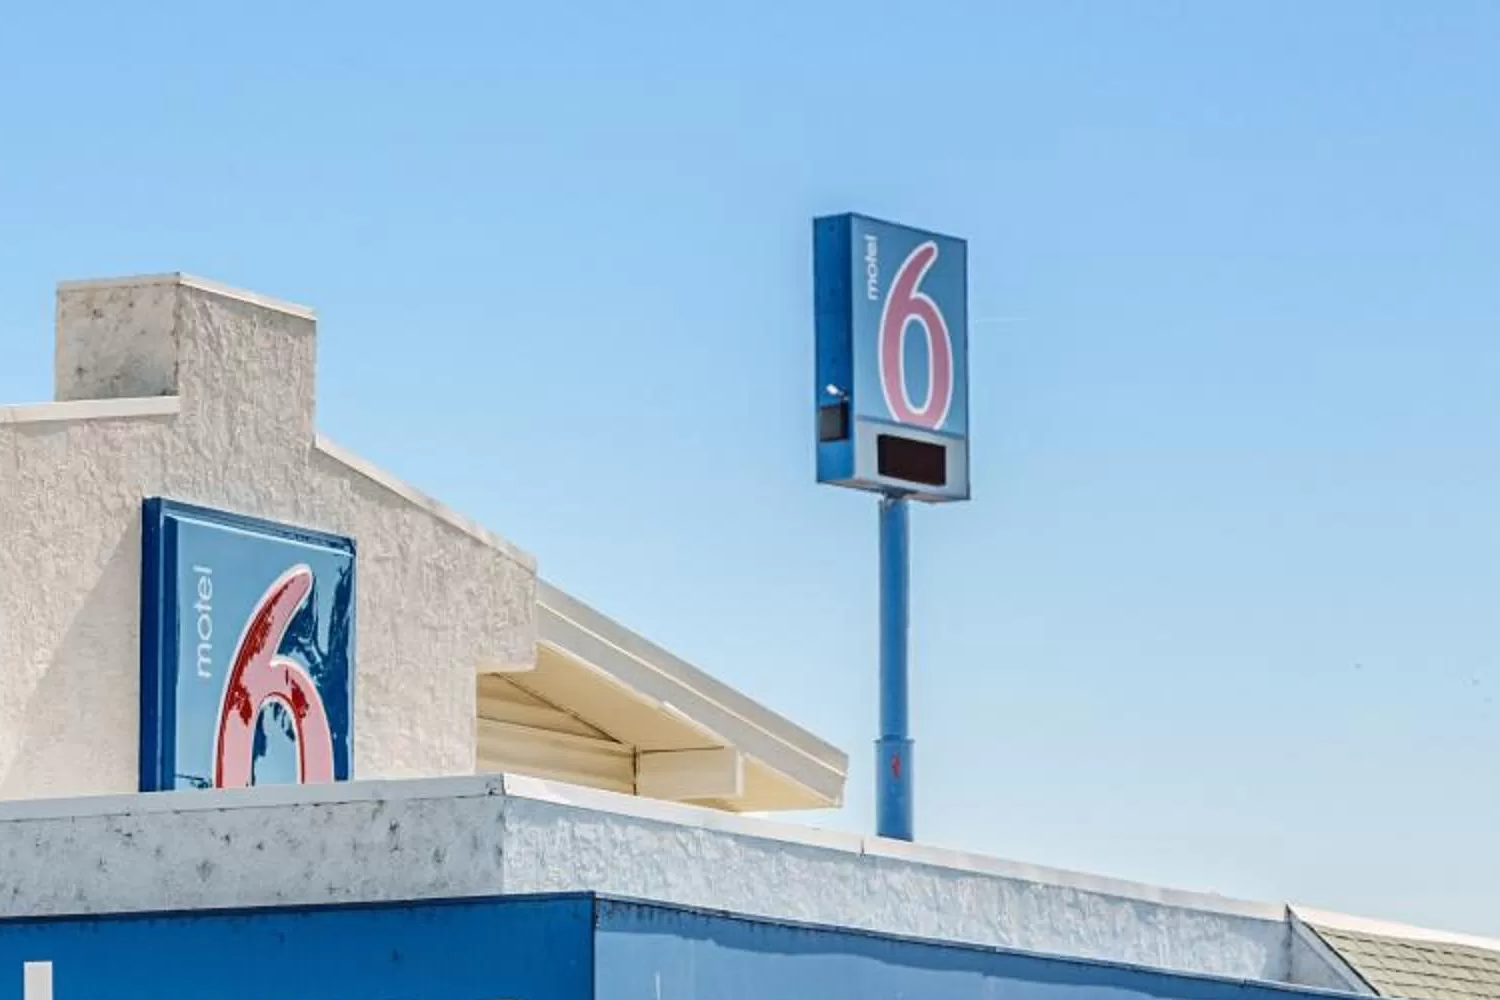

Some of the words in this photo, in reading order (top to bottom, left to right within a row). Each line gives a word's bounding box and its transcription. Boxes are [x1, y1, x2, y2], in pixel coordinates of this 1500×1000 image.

[864, 235, 880, 300] motel
[878, 241, 954, 430] 6
[193, 565, 213, 679] motel
[212, 563, 335, 788] 6
